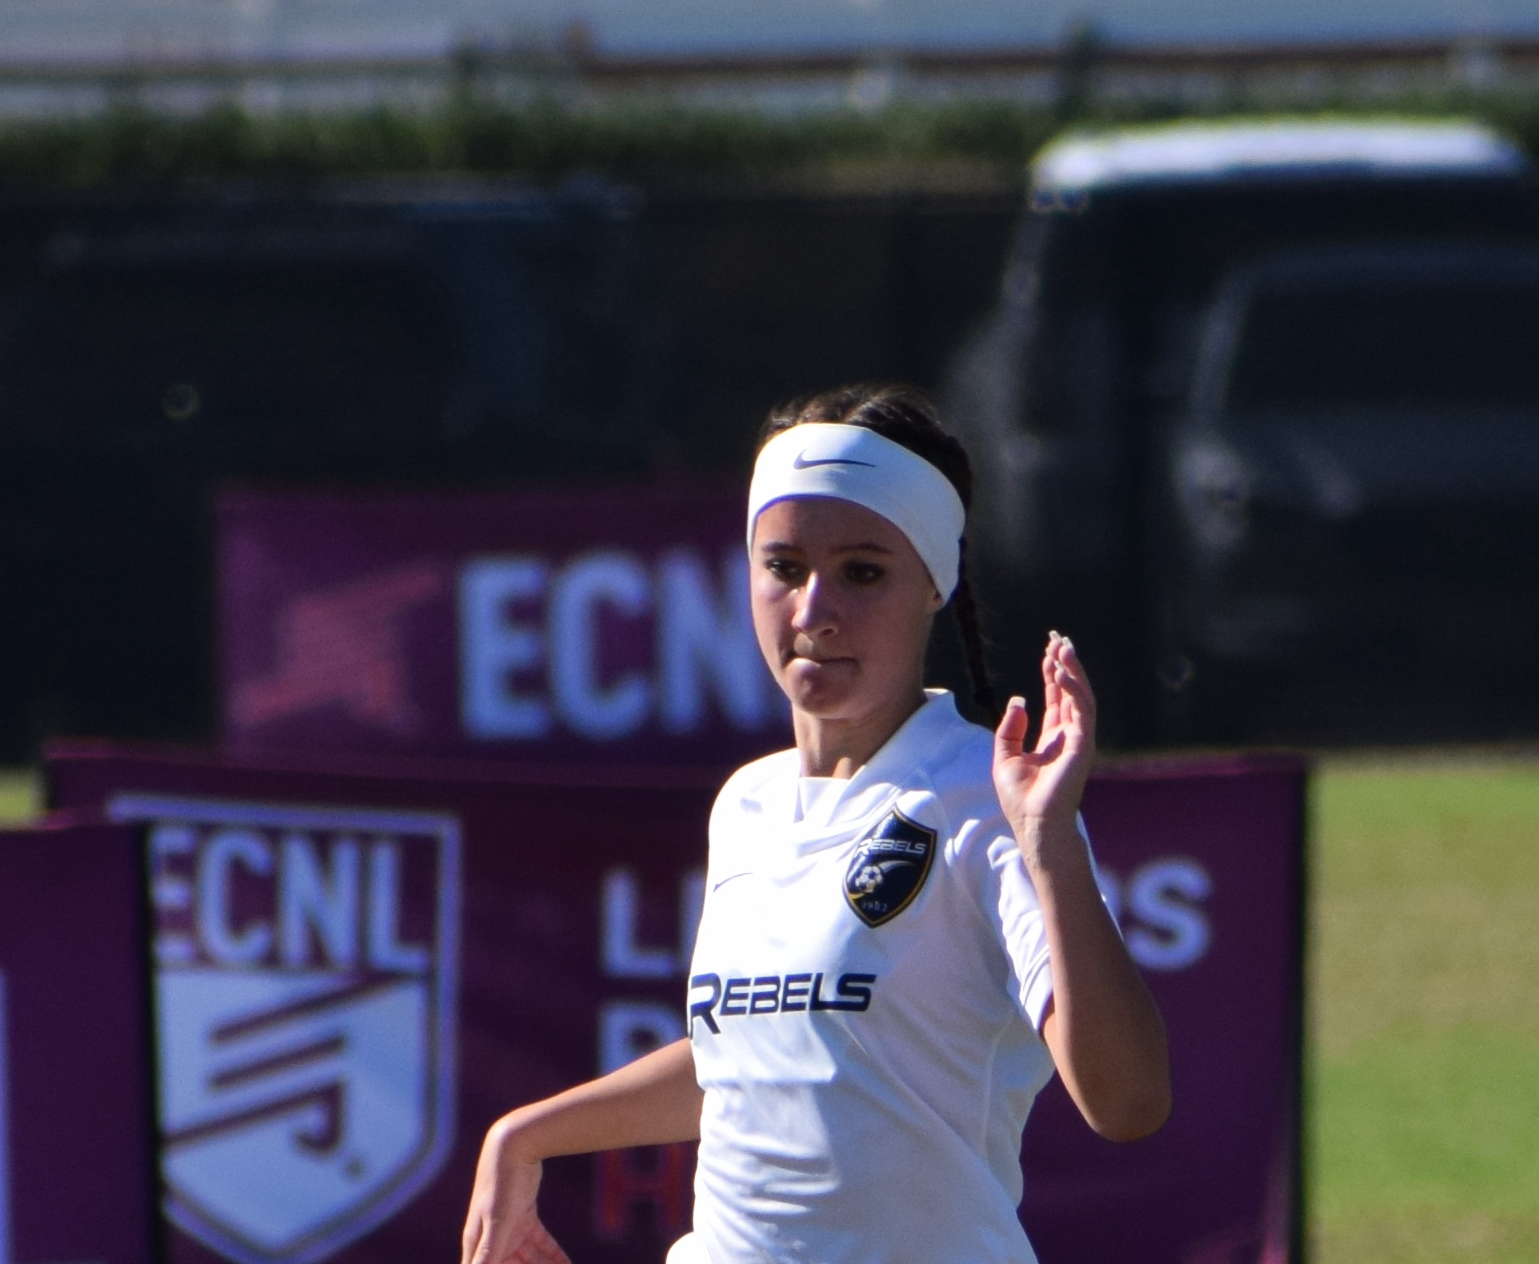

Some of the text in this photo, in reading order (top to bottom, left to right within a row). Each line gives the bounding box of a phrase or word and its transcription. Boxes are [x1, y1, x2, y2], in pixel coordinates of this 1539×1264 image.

[460, 552, 769, 738] ECN
[151, 828, 429, 972] ECNL
[854, 838, 926, 858] REBELS
[689, 972, 877, 1040] REBELS
